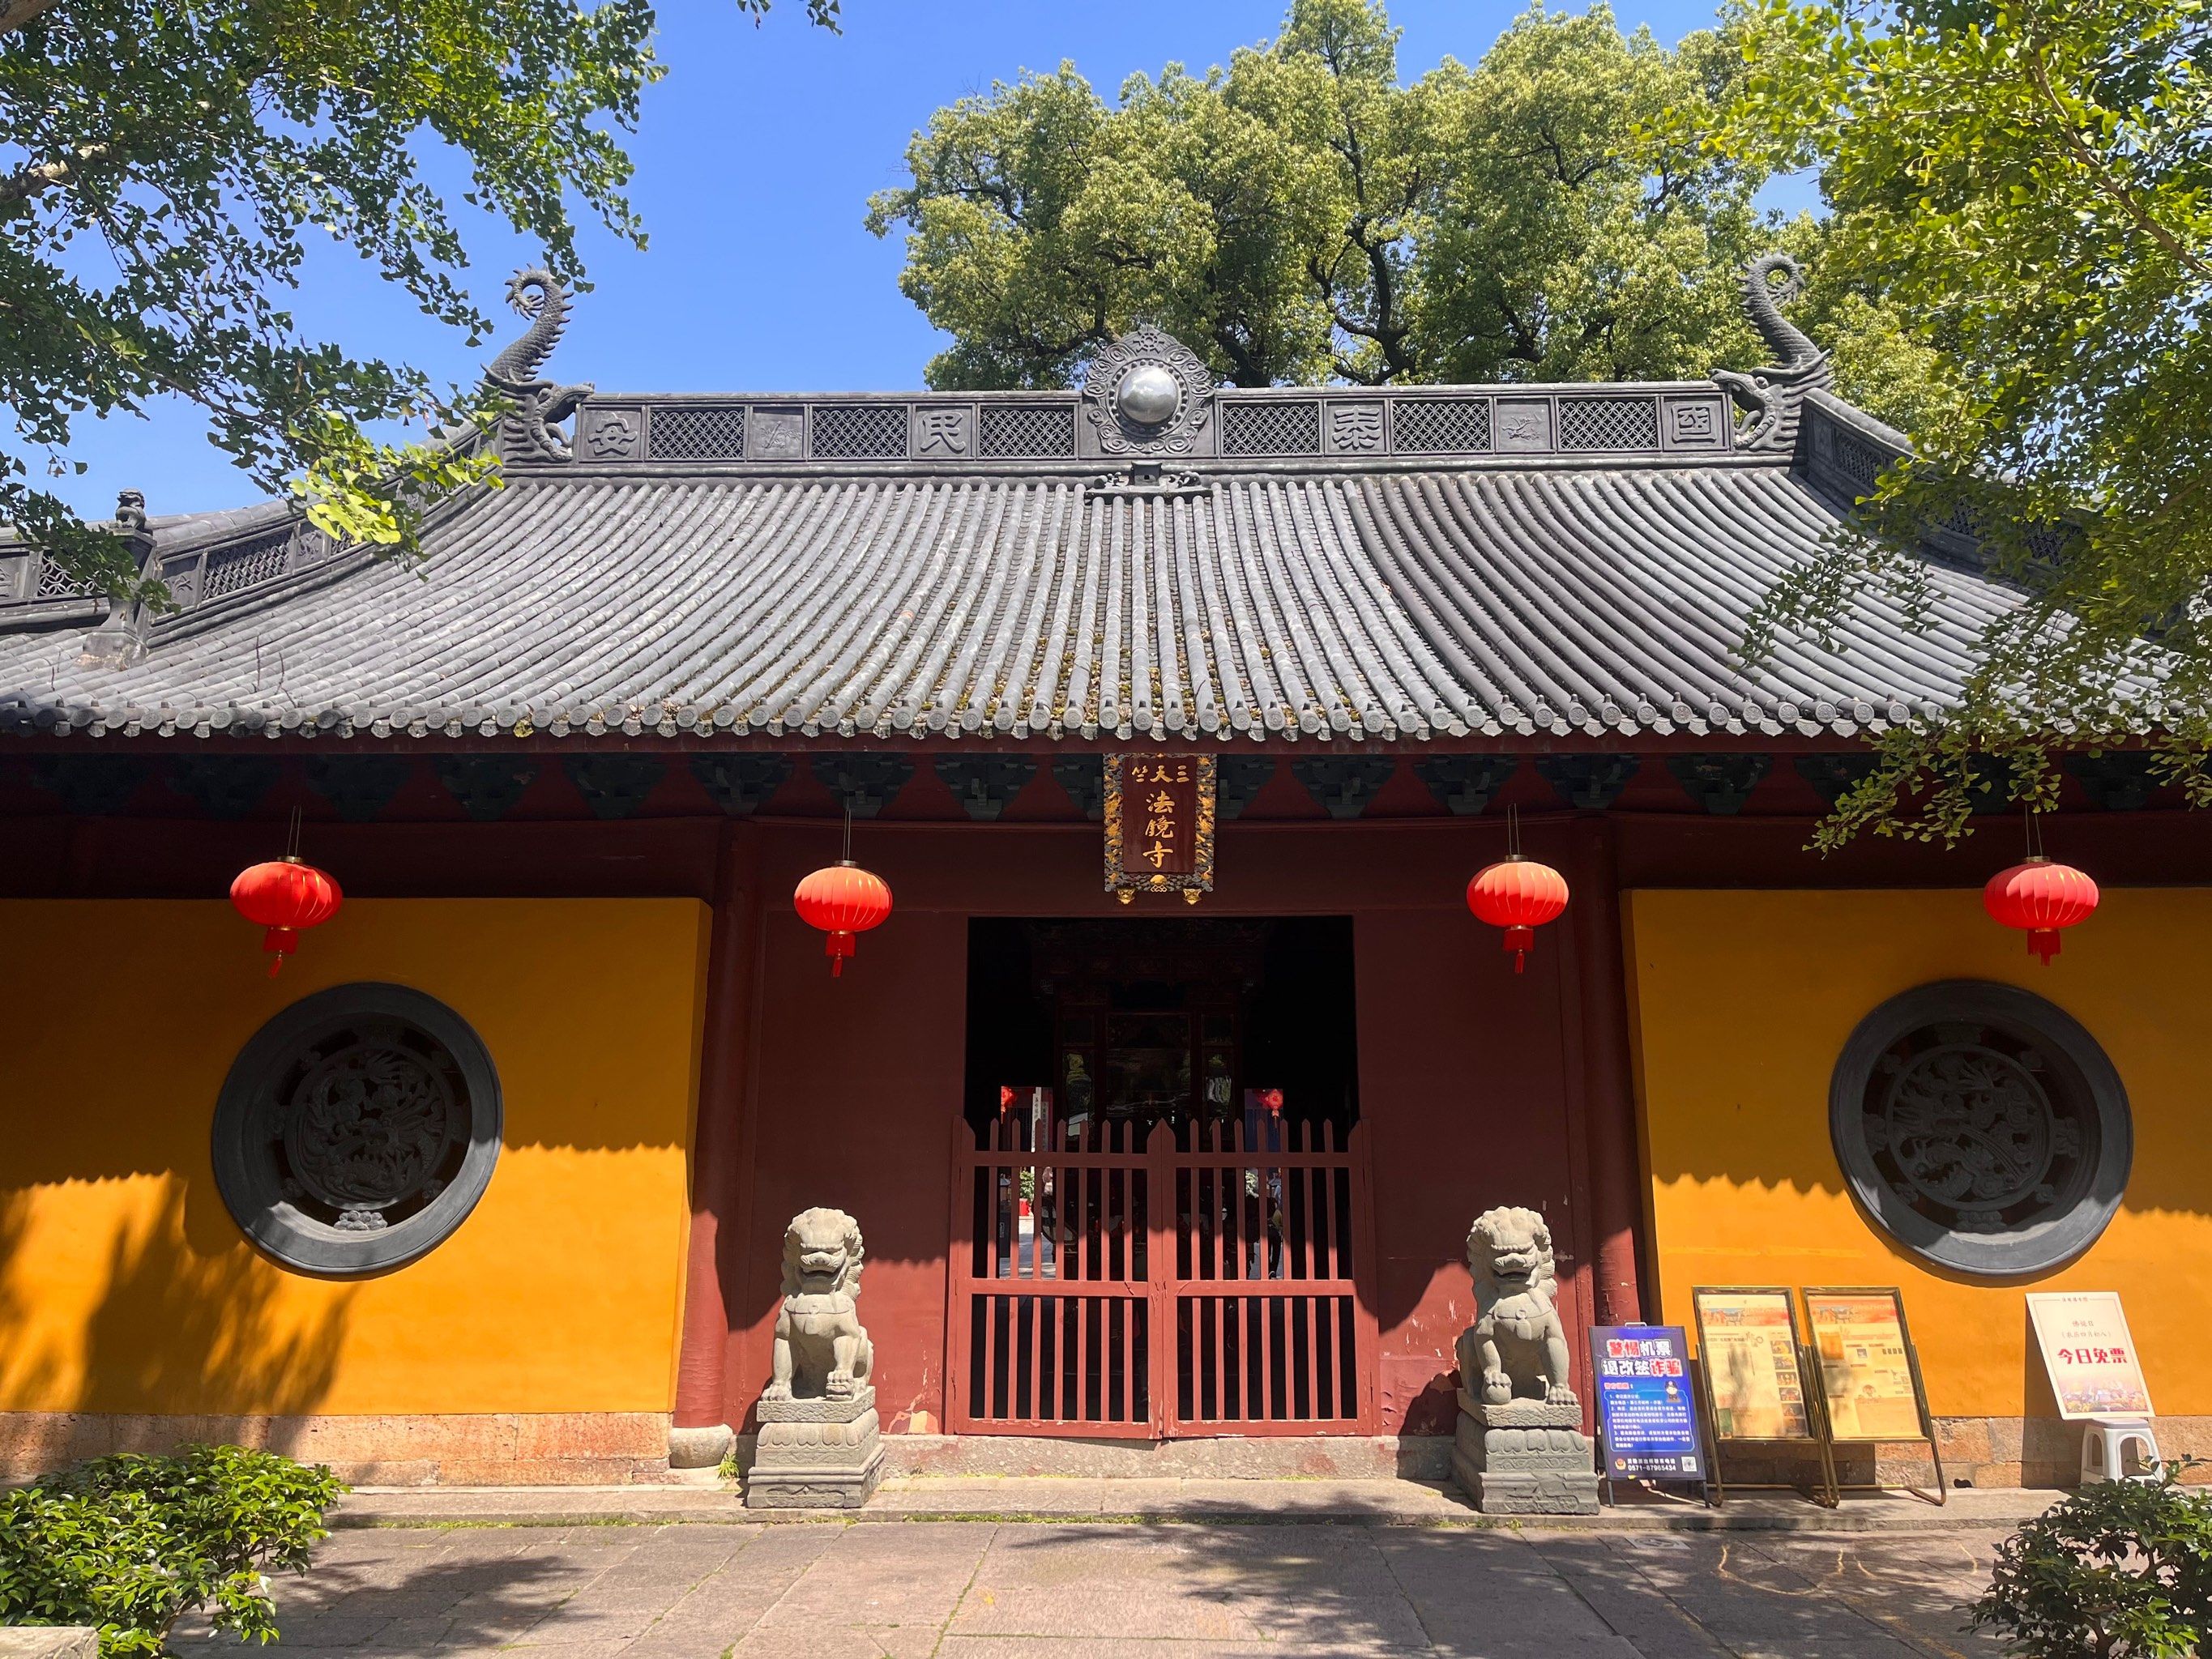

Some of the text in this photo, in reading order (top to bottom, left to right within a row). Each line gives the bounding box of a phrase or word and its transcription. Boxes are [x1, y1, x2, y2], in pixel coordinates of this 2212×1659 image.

[587, 412, 638, 456] 安
[920, 412, 966, 454] 民
[1332, 405, 1381, 450] 泰
[1607, 1338, 1672, 1358] 警惕机票
[2057, 1348, 2127, 1365] 今日免票
[1602, 1358, 1683, 1377] 退改签诈骗
